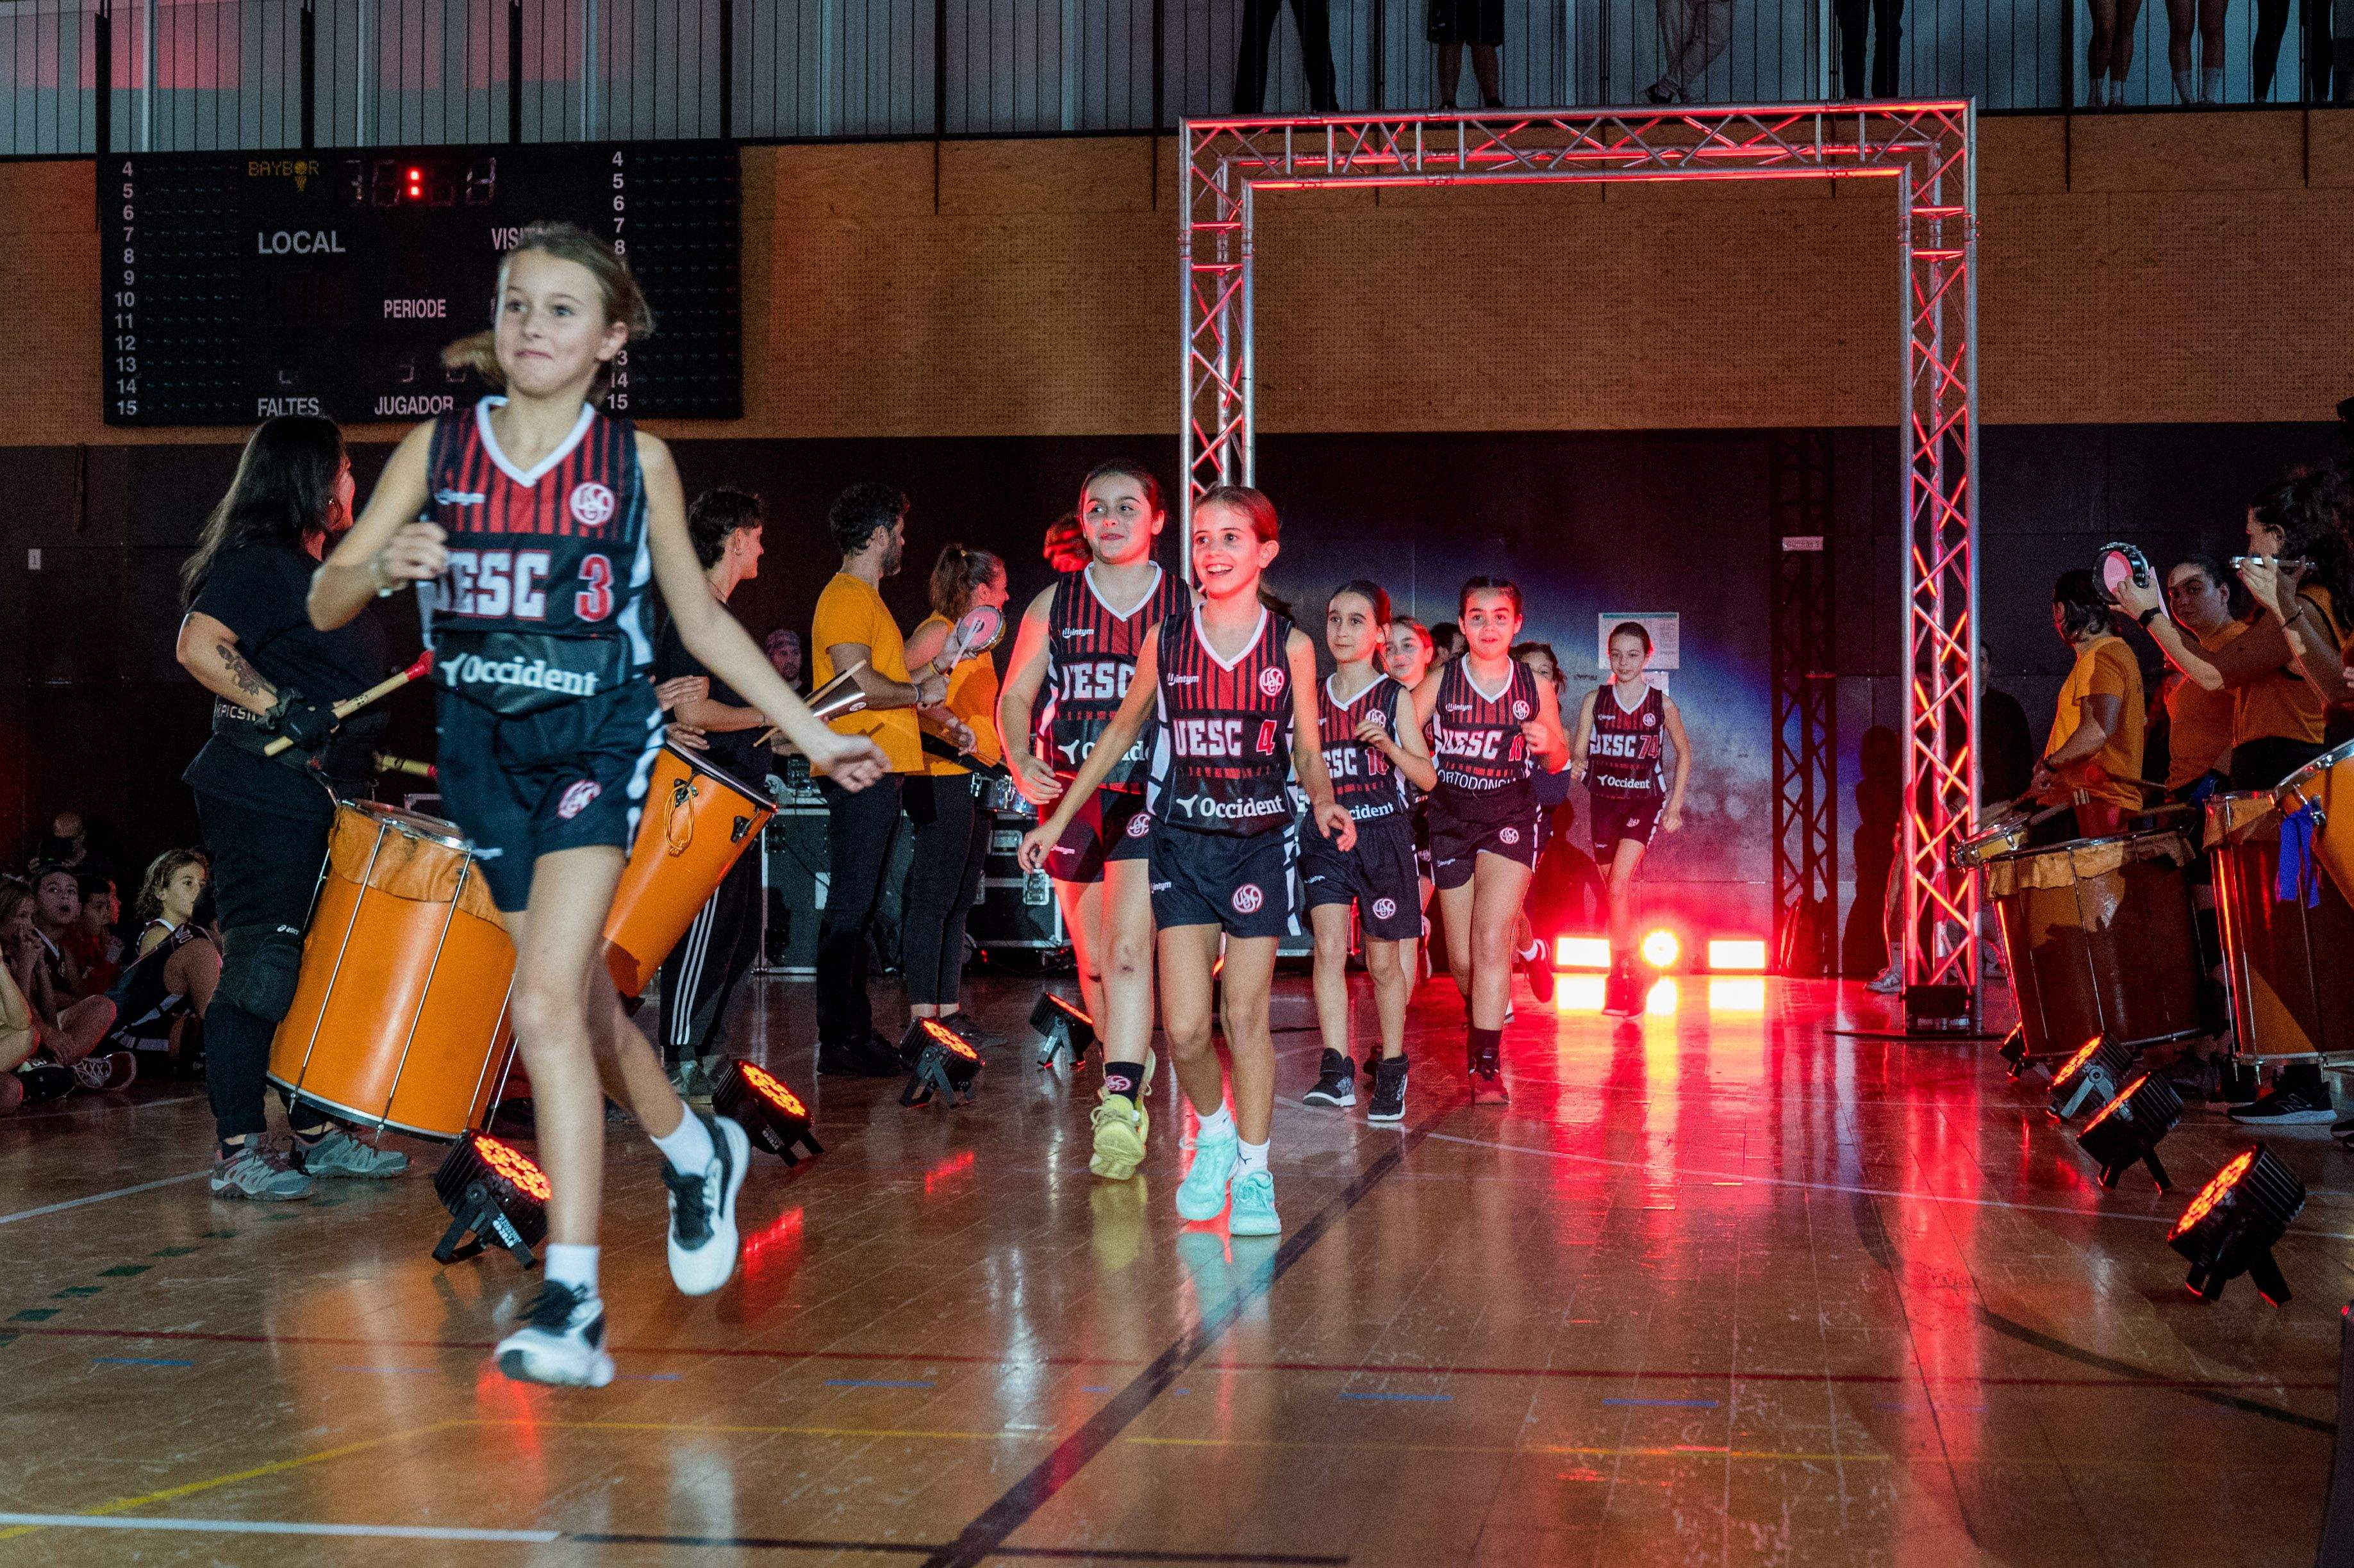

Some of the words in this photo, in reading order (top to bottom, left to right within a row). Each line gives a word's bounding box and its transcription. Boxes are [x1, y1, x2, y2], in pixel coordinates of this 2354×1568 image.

[612, 152, 624, 167] 4
[122, 161, 133, 176] 4
[613, 174, 624, 188] 5
[122, 183, 133, 199] 5
[613, 195, 625, 210] 6
[123, 205, 134, 220] 6
[613, 218, 625, 233] 7
[123, 227, 134, 242] 7
[258, 230, 345, 254] LOCAL
[614, 239, 626, 254] 8
[123, 249, 135, 263] 8
[123, 270, 135, 285] 9
[115, 292, 135, 307] 10
[384, 299, 446, 318] PERIODE
[115, 313, 134, 328] 11
[115, 335, 136, 351] 12
[115, 357, 137, 372] 13
[612, 350, 628, 366] 3
[117, 379, 137, 394] 14
[117, 400, 137, 416] 15
[257, 397, 320, 417] FALTES
[374, 395, 454, 416] JUGADOR
[607, 394, 629, 410] 15
[575, 554, 614, 622] 3
[461, 654, 600, 697] Occident
[1173, 718, 1243, 757] UESC
[1256, 719, 1277, 756] 4
[1440, 728, 1504, 761] UESC
[1638, 734, 1659, 760] 74
[1322, 747, 1358, 779] ESC
[1607, 776, 1650, 789] Occident
[1200, 795, 1286, 819] Occident
[1348, 802, 1395, 820] cident
